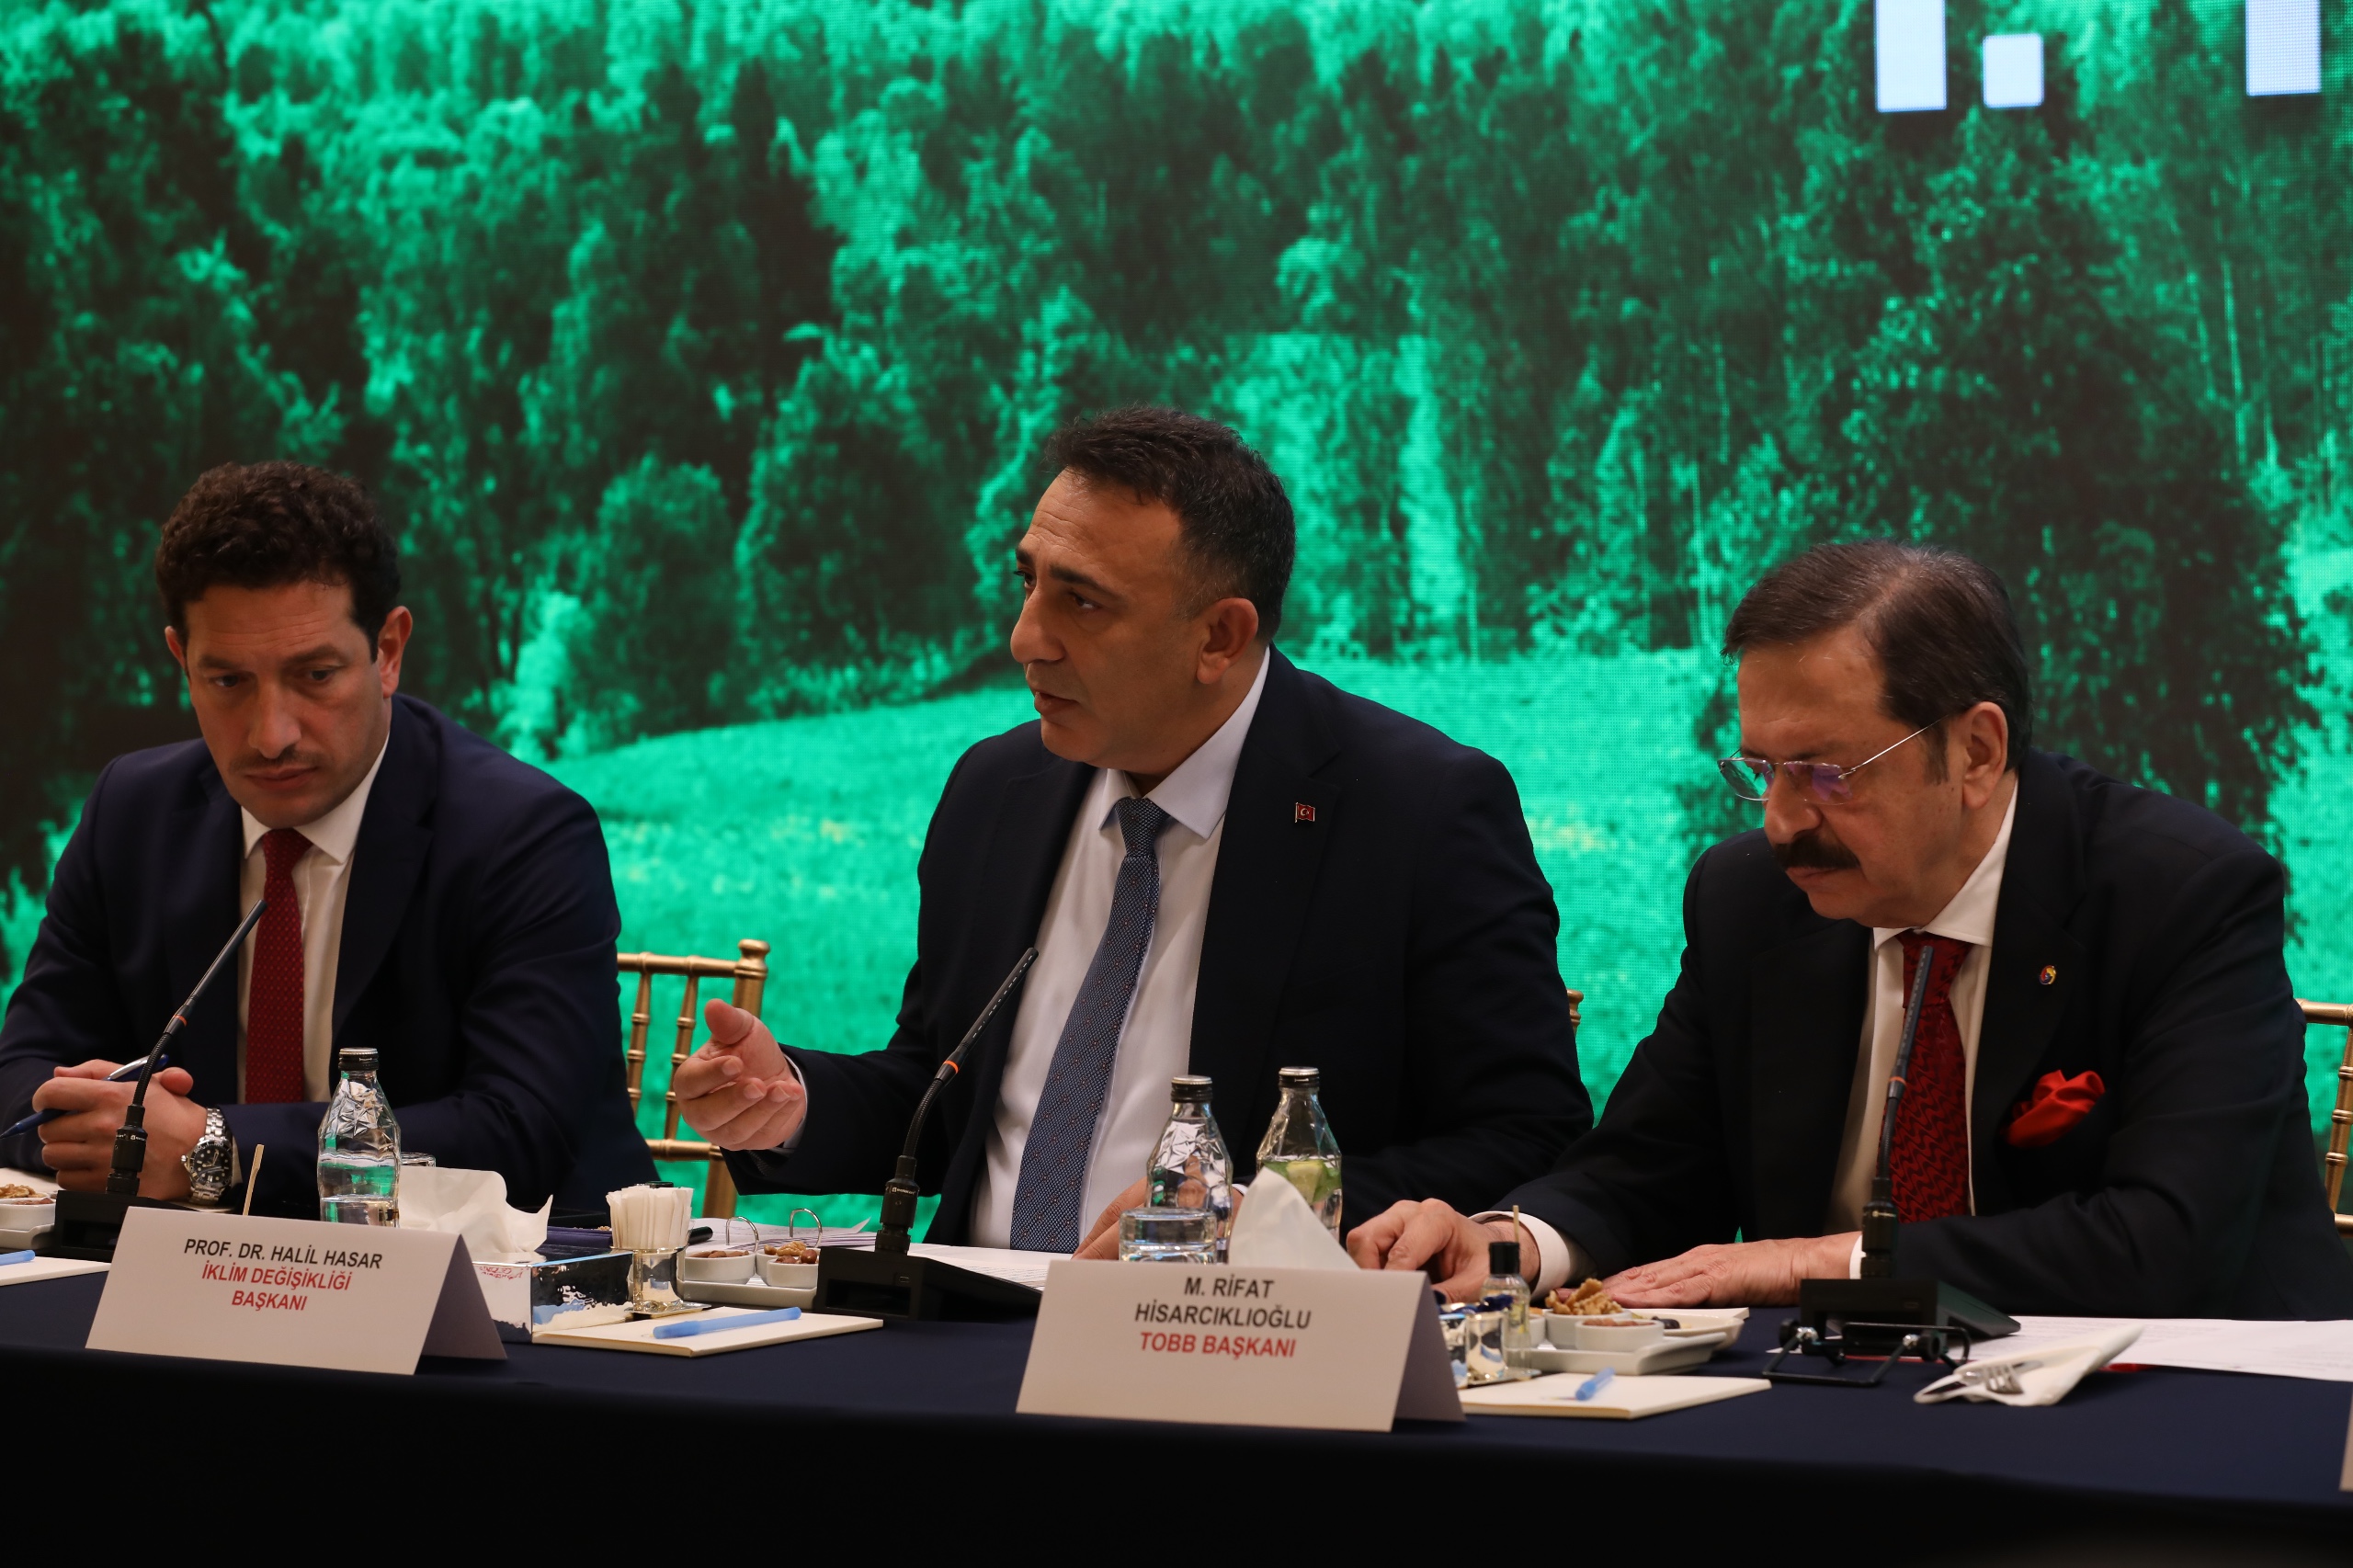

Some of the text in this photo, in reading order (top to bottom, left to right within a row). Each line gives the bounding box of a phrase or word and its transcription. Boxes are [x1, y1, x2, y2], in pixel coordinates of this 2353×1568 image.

[184, 1238, 382, 1269] PROF. DR. HALİL HASAR
[201, 1260, 353, 1290] İKLİM DEĞİŞİKLİĞİ
[1184, 1274, 1275, 1299] M. RİFAT
[231, 1290, 308, 1312] BAŞKANI
[1134, 1299, 1312, 1330] HİSARCIKLIOĞLU
[1140, 1332, 1296, 1360] TOBB BAŞKANI
